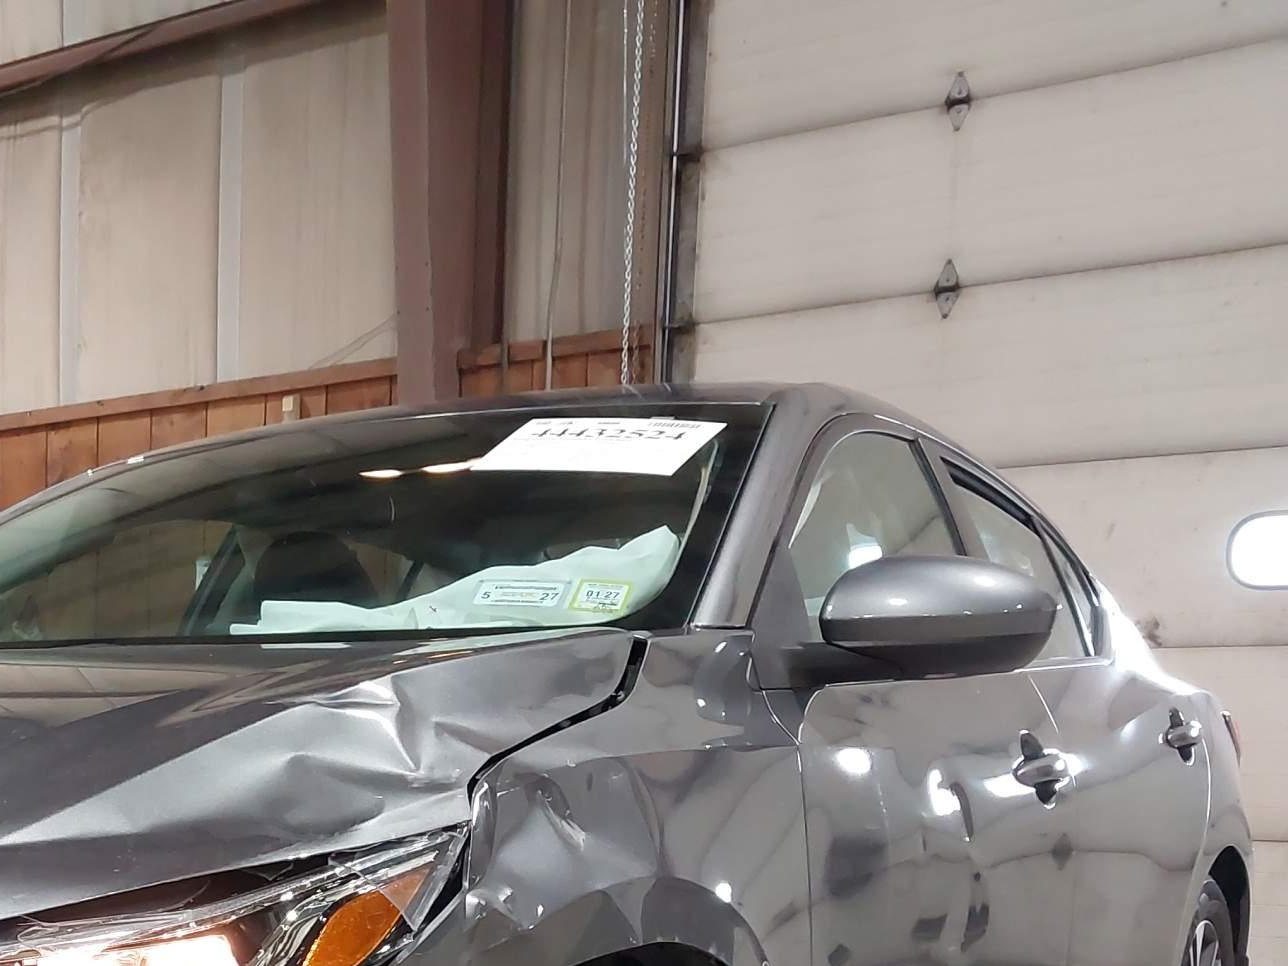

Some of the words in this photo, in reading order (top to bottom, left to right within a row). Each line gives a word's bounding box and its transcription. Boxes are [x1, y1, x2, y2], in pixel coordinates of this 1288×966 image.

[531, 427, 686, 441] 44432524
[481, 591, 491, 600] 5
[539, 592, 560, 601] 27
